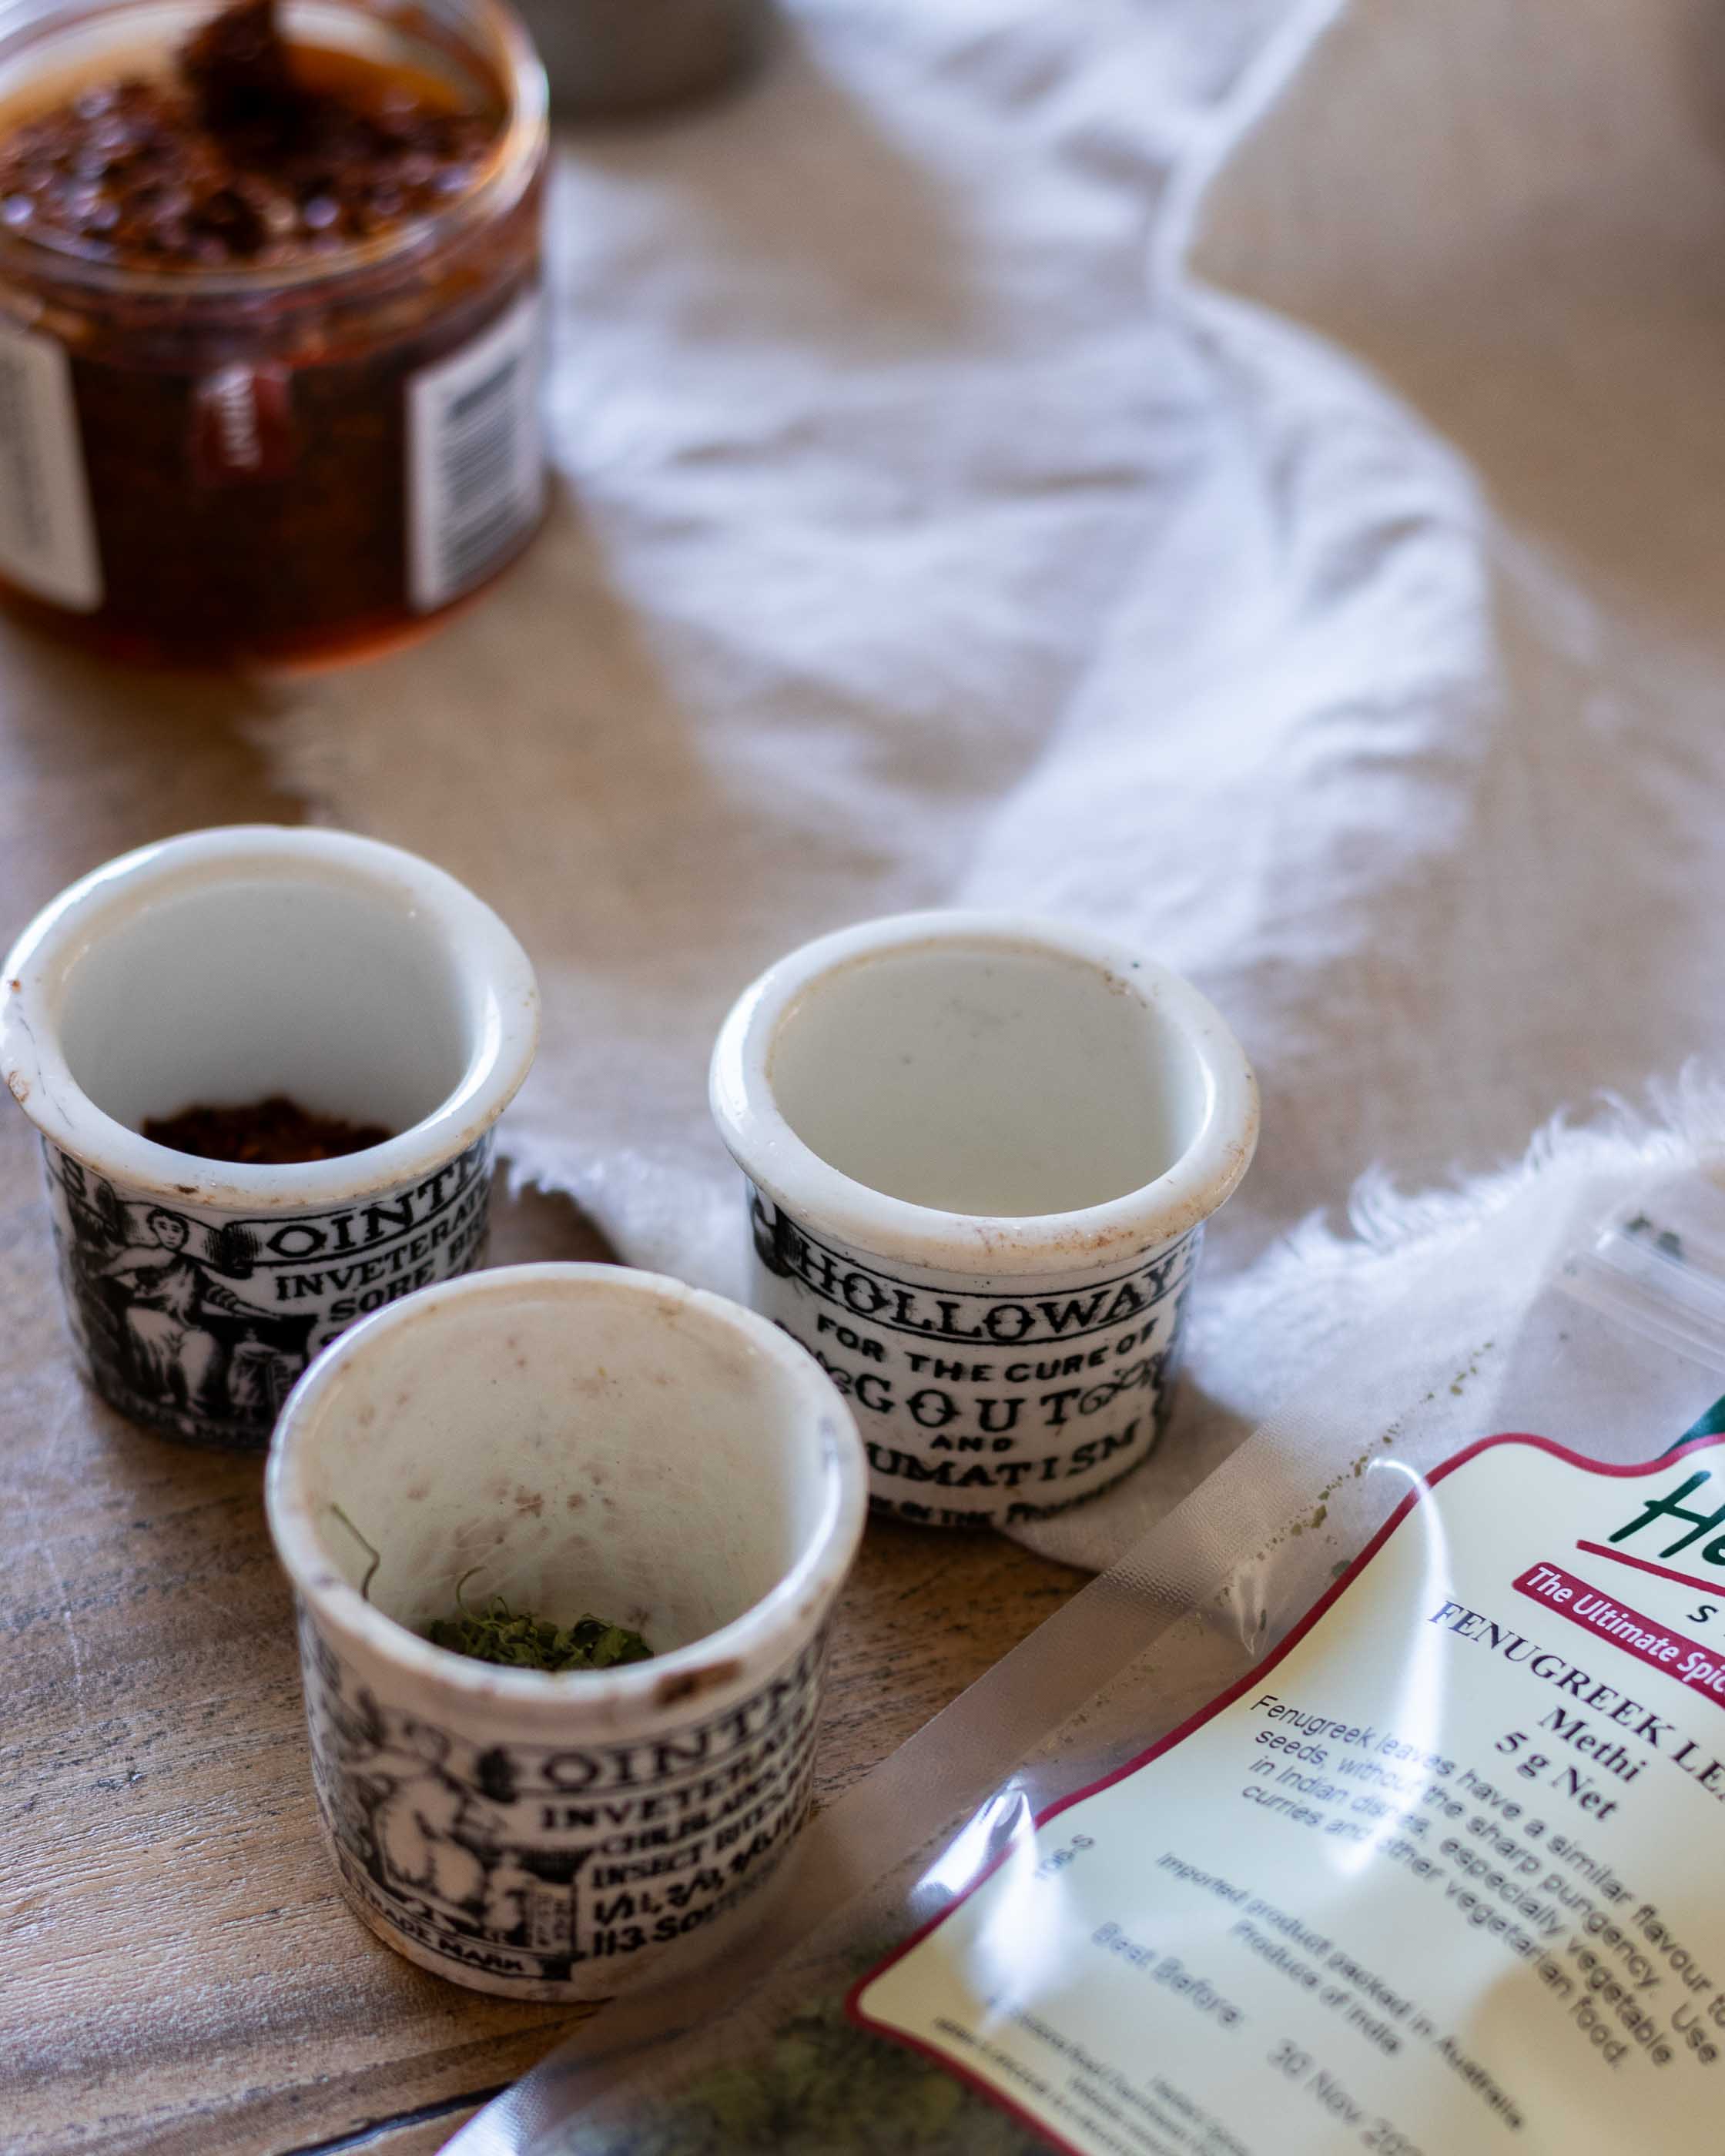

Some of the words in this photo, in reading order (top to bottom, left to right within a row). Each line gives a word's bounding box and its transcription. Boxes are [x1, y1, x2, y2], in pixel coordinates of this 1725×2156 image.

[816, 1314, 885, 1362] FOR
[903, 1351, 994, 1383] THE
[1005, 1346, 1109, 1383] CURE
[1115, 1317, 1159, 1355] OF
[854, 1373, 1080, 1432] GOUT
[930, 1435, 1013, 1453] AND
[866, 1418, 1141, 1487] UMATISM
[1526, 1566, 1573, 1603] The
[1572, 1593, 1680, 1662] Ultimate
[1427, 1600, 1676, 1748] FENUGREEK
[1668, 1739, 1725, 1803] LE
[1537, 1706, 1649, 1783] Methi
[1495, 1731, 1529, 1755] 5
[1516, 1753, 1551, 1779] g
[1550, 1766, 1619, 1821] Net
[1242, 1784, 1323, 1827] curries
[1445, 1880, 1575, 2000] vegetarian
[1251, 1695, 1375, 1749] Fenugreek
[1375, 1732, 1456, 1777] leaes
[1456, 1768, 1522, 1821] have
[1523, 1820, 1546, 1838] a
[1547, 1834, 1635, 1904] similar
[1630, 1903, 1713, 1994] flavour
[1156, 1852, 1251, 1905] Imported
[1326, 1951, 1413, 2019] packed
[1248, 1755, 1275, 1776] in
[1275, 1766, 1349, 1803] Indian
[1350, 1795, 1431, 1840] dises,
[1439, 1837, 1566, 1937] especially
[1567, 1935, 1673, 2067] vegetable
[1255, 1730, 1328, 1770] seeds,
[1422, 1784, 1465, 1820] the
[1466, 1815, 1541, 1875] sharp
[1671, 2002, 1718, 2065] Use
